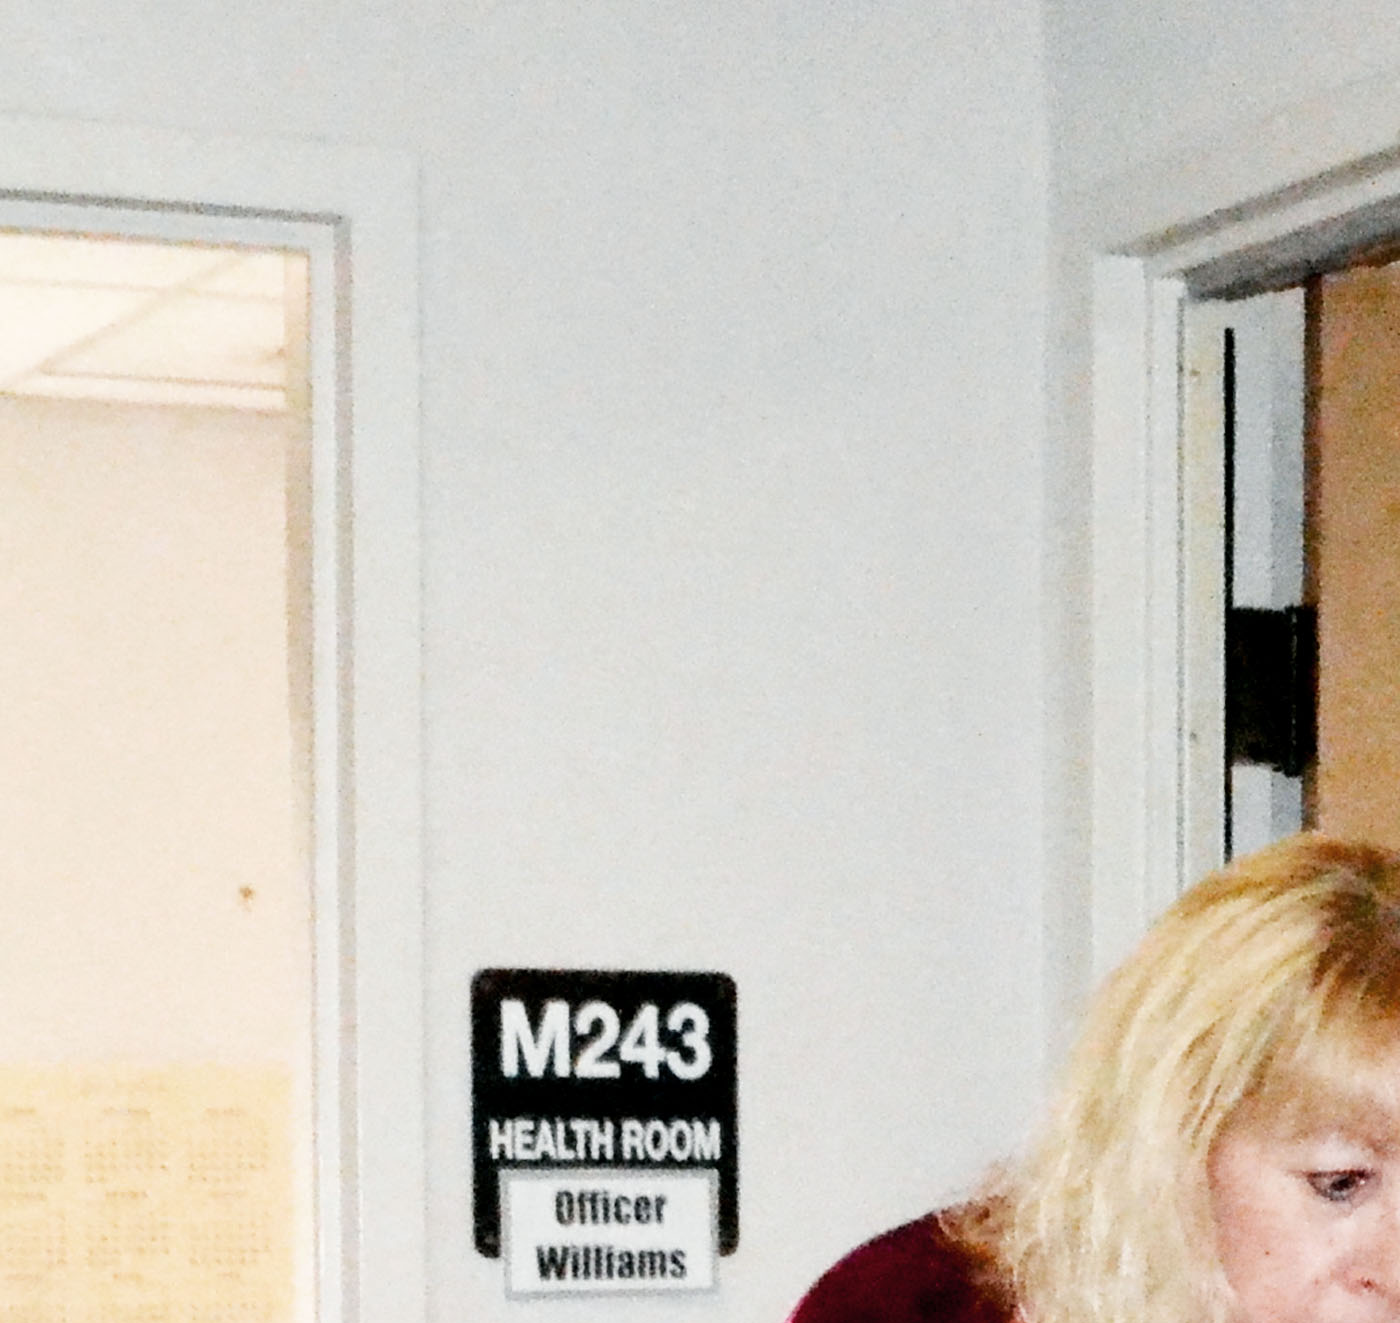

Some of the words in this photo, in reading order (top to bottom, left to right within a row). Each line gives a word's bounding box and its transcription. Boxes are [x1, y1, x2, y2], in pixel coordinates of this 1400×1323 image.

[500, 999, 712, 1080] M243
[488, 1118, 614, 1161] HEALTH
[621, 1119, 722, 1162] ROOM
[554, 1190, 667, 1226] Officer
[536, 1244, 687, 1281] Williams
